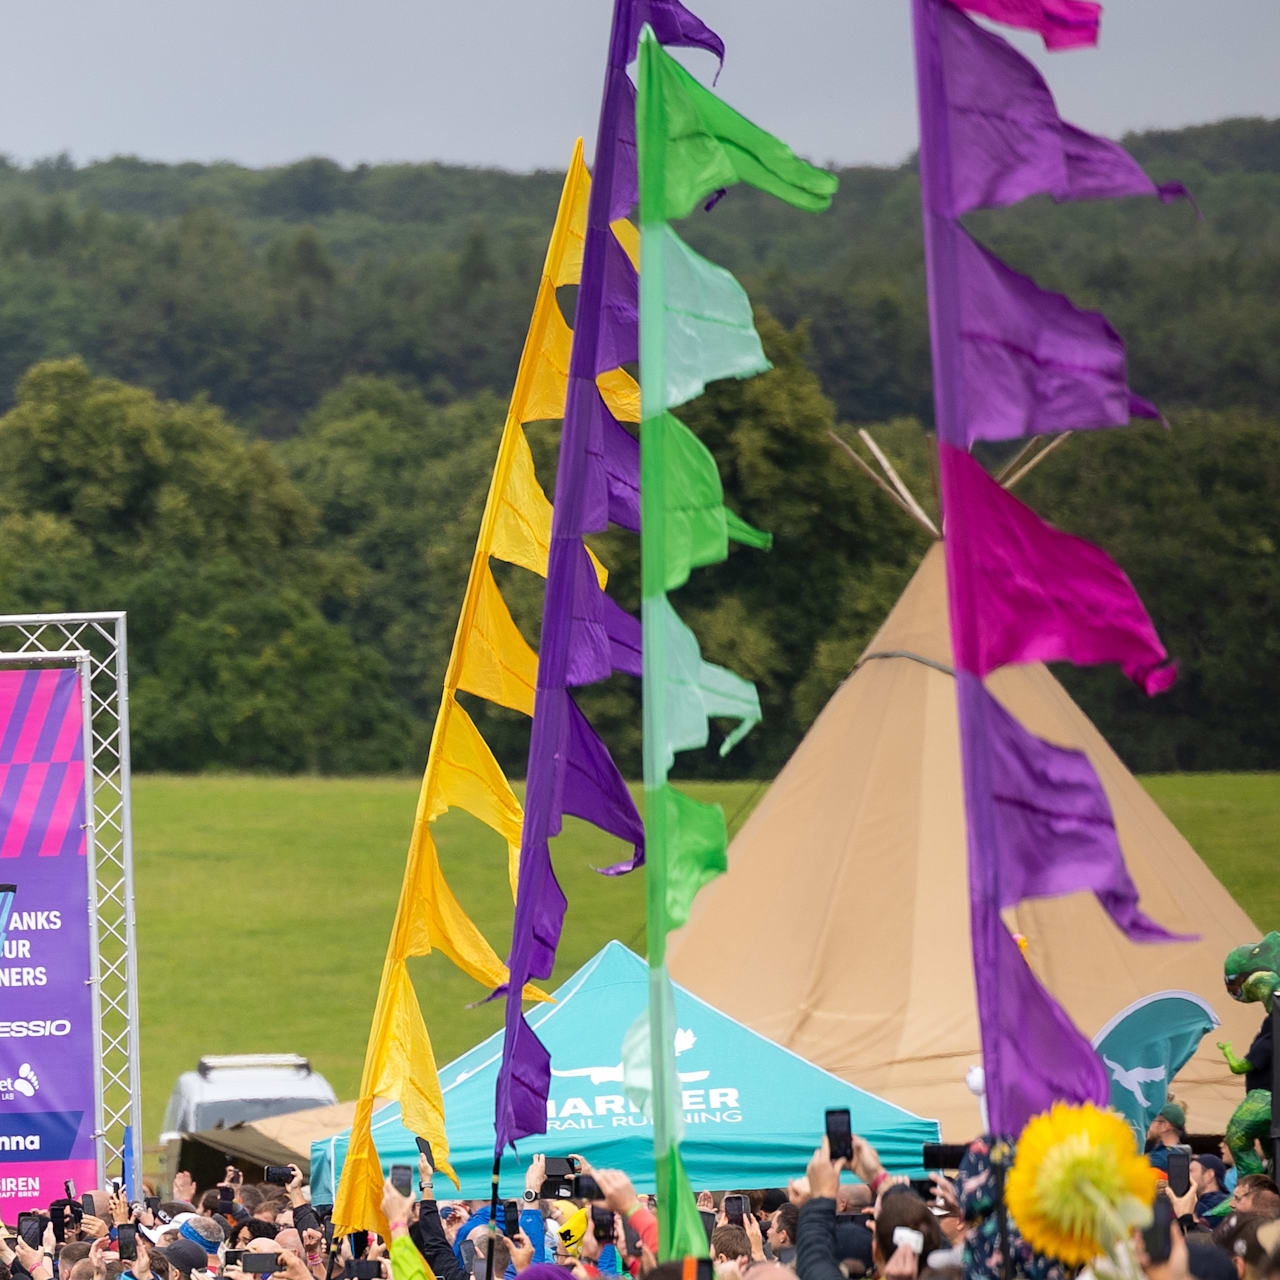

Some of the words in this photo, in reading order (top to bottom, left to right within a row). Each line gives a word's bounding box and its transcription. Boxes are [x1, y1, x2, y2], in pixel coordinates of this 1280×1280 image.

[9, 911, 61, 931] ANKS
[0, 939, 31, 958] UR
[546, 1118, 605, 1131] RAIL
